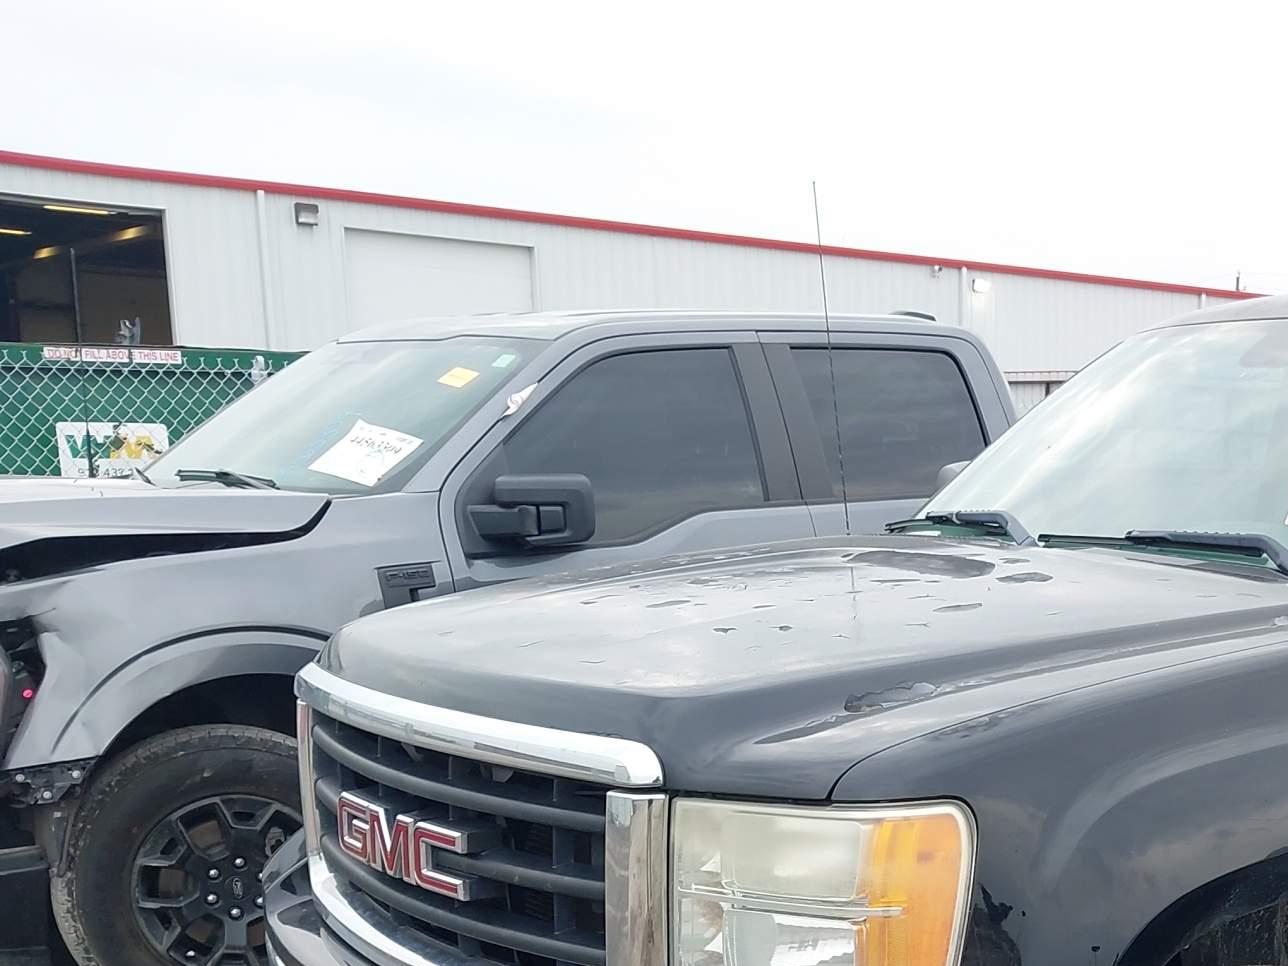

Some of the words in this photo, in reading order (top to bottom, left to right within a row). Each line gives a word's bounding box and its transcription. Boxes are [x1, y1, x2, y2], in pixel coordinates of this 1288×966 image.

[48, 349, 61, 359] DO
[85, 350, 105, 360] FILL
[138, 352, 158, 362] THIS
[159, 352, 178, 362] LINE
[338, 791, 472, 901] GMC
